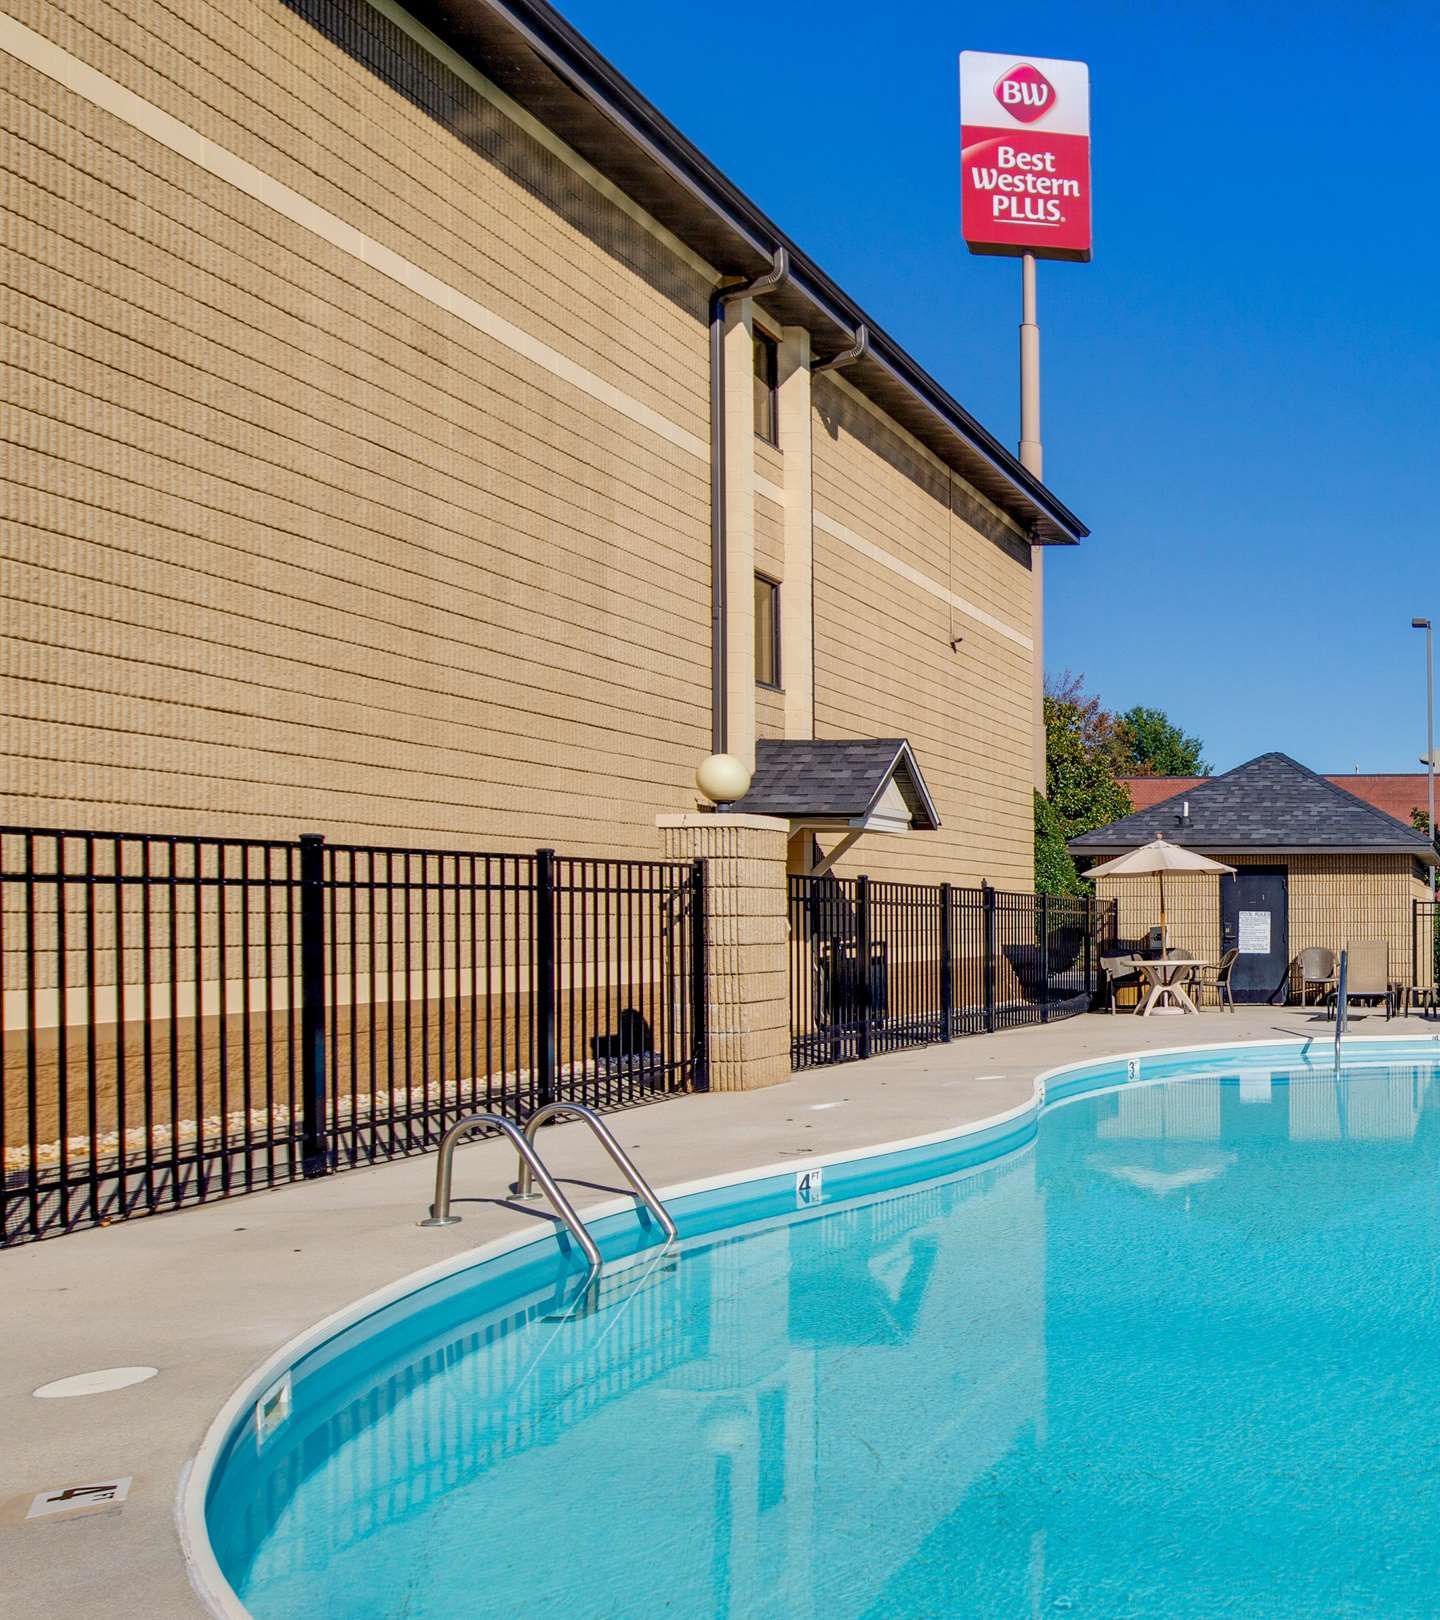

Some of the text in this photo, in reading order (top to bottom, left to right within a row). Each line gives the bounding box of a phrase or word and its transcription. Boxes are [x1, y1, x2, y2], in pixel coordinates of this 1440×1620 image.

[1002, 80, 1049, 107] BW
[997, 146, 1057, 172] Best
[971, 167, 1080, 197] Western
[798, 1173, 811, 1191] 4
[46, 1485, 118, 1503] 4
